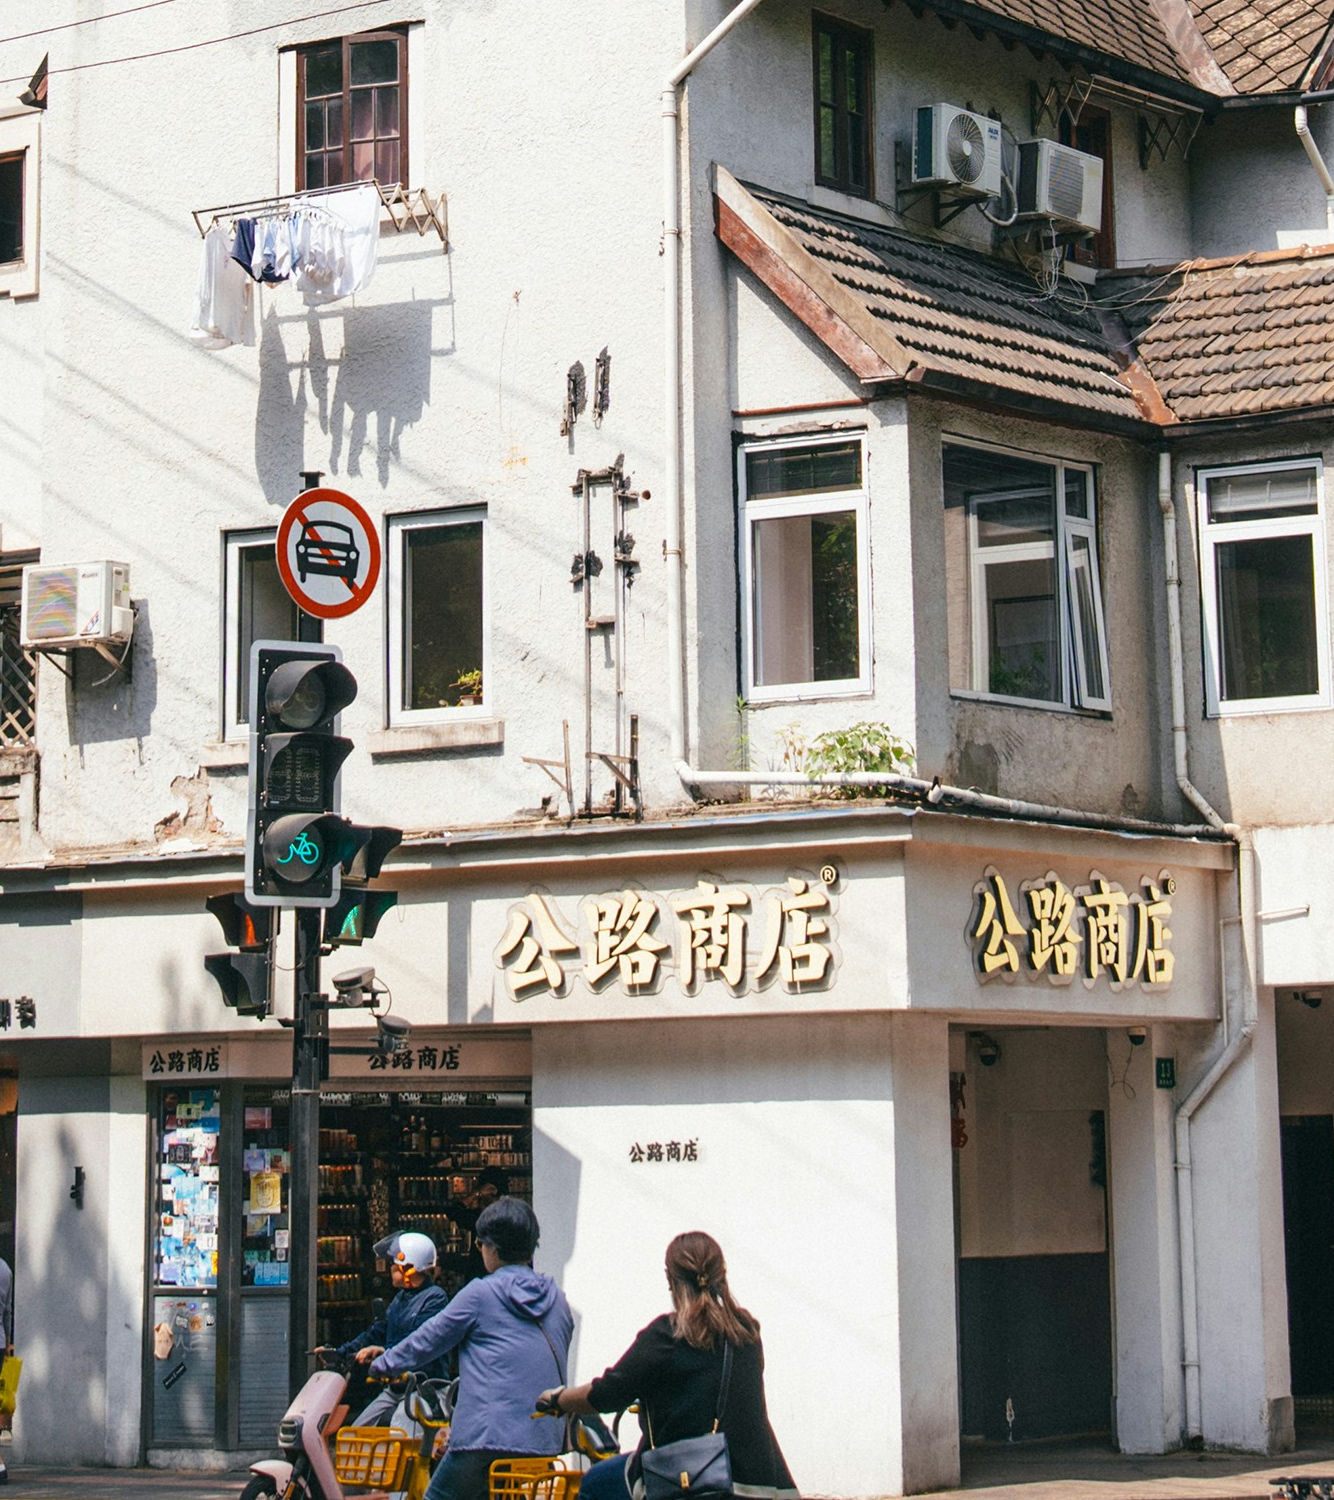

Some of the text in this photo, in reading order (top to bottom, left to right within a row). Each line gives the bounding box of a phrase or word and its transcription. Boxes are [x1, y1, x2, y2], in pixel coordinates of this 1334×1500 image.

[496, 880, 832, 992] 公路商店
[971, 875, 1175, 983] 公路商店
[149, 1048, 220, 1074] 公路商店
[368, 1043, 462, 1071] 公路商店
[629, 1139, 698, 1163] 公路商店
